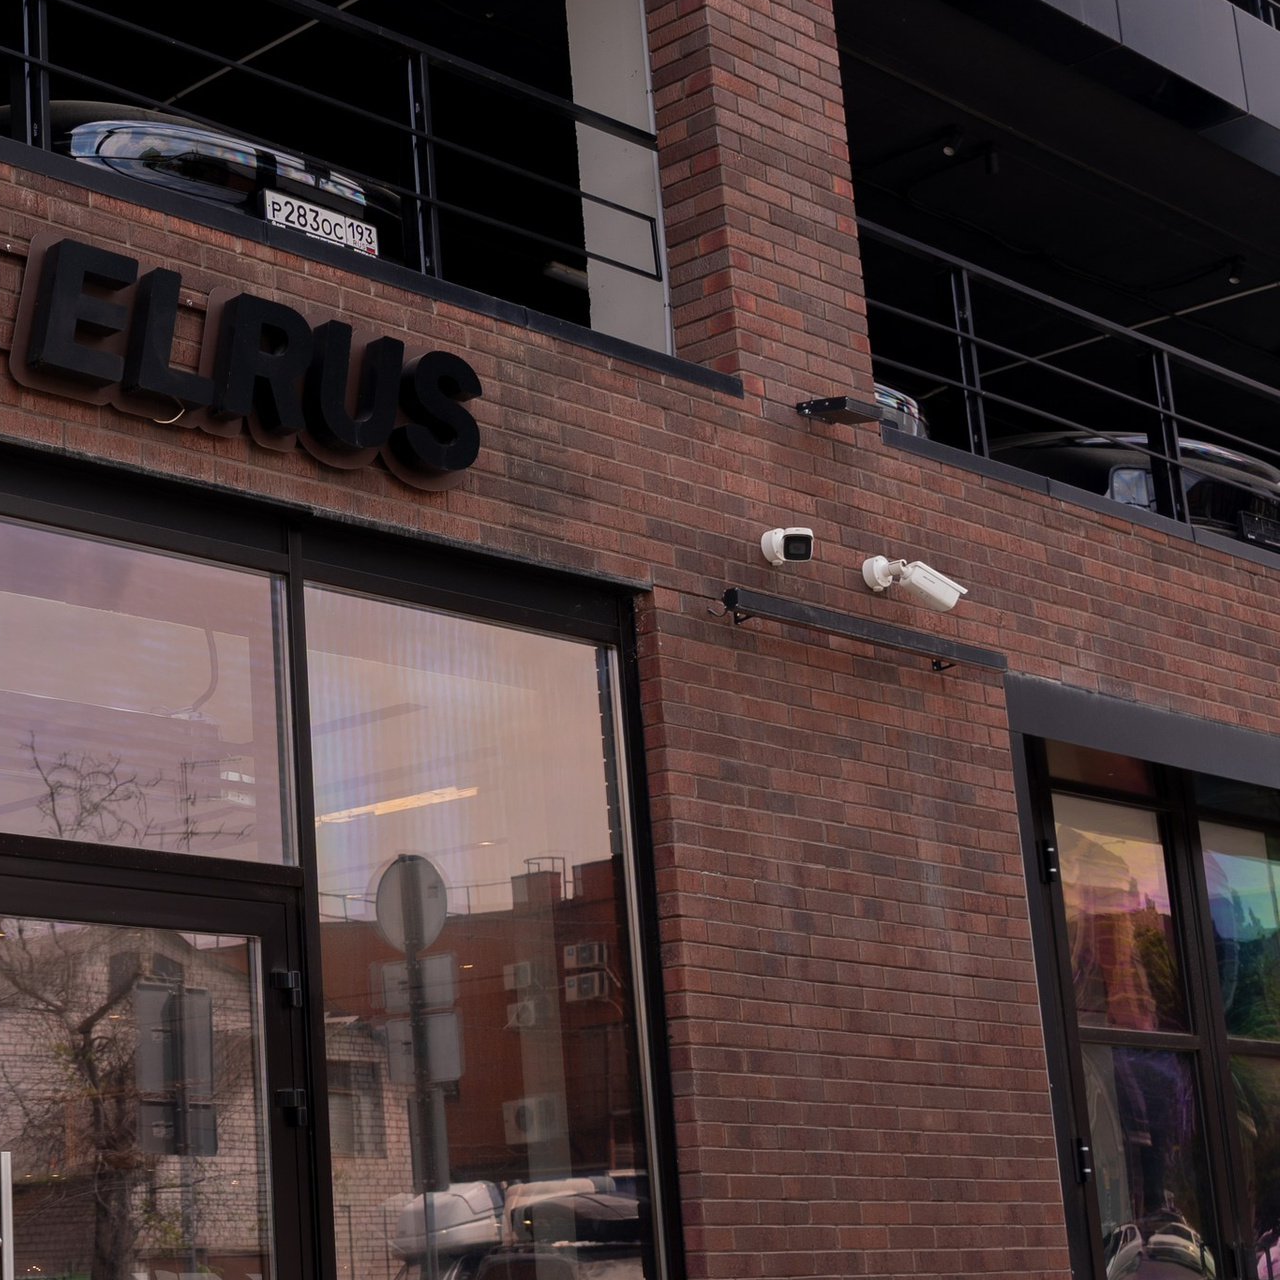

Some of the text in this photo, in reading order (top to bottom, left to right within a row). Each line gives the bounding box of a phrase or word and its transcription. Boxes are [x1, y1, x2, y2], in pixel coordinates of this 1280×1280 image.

[347, 221, 373, 245] 193
[352, 239, 367, 250] RUS
[25, 237, 484, 473] ELRUS
